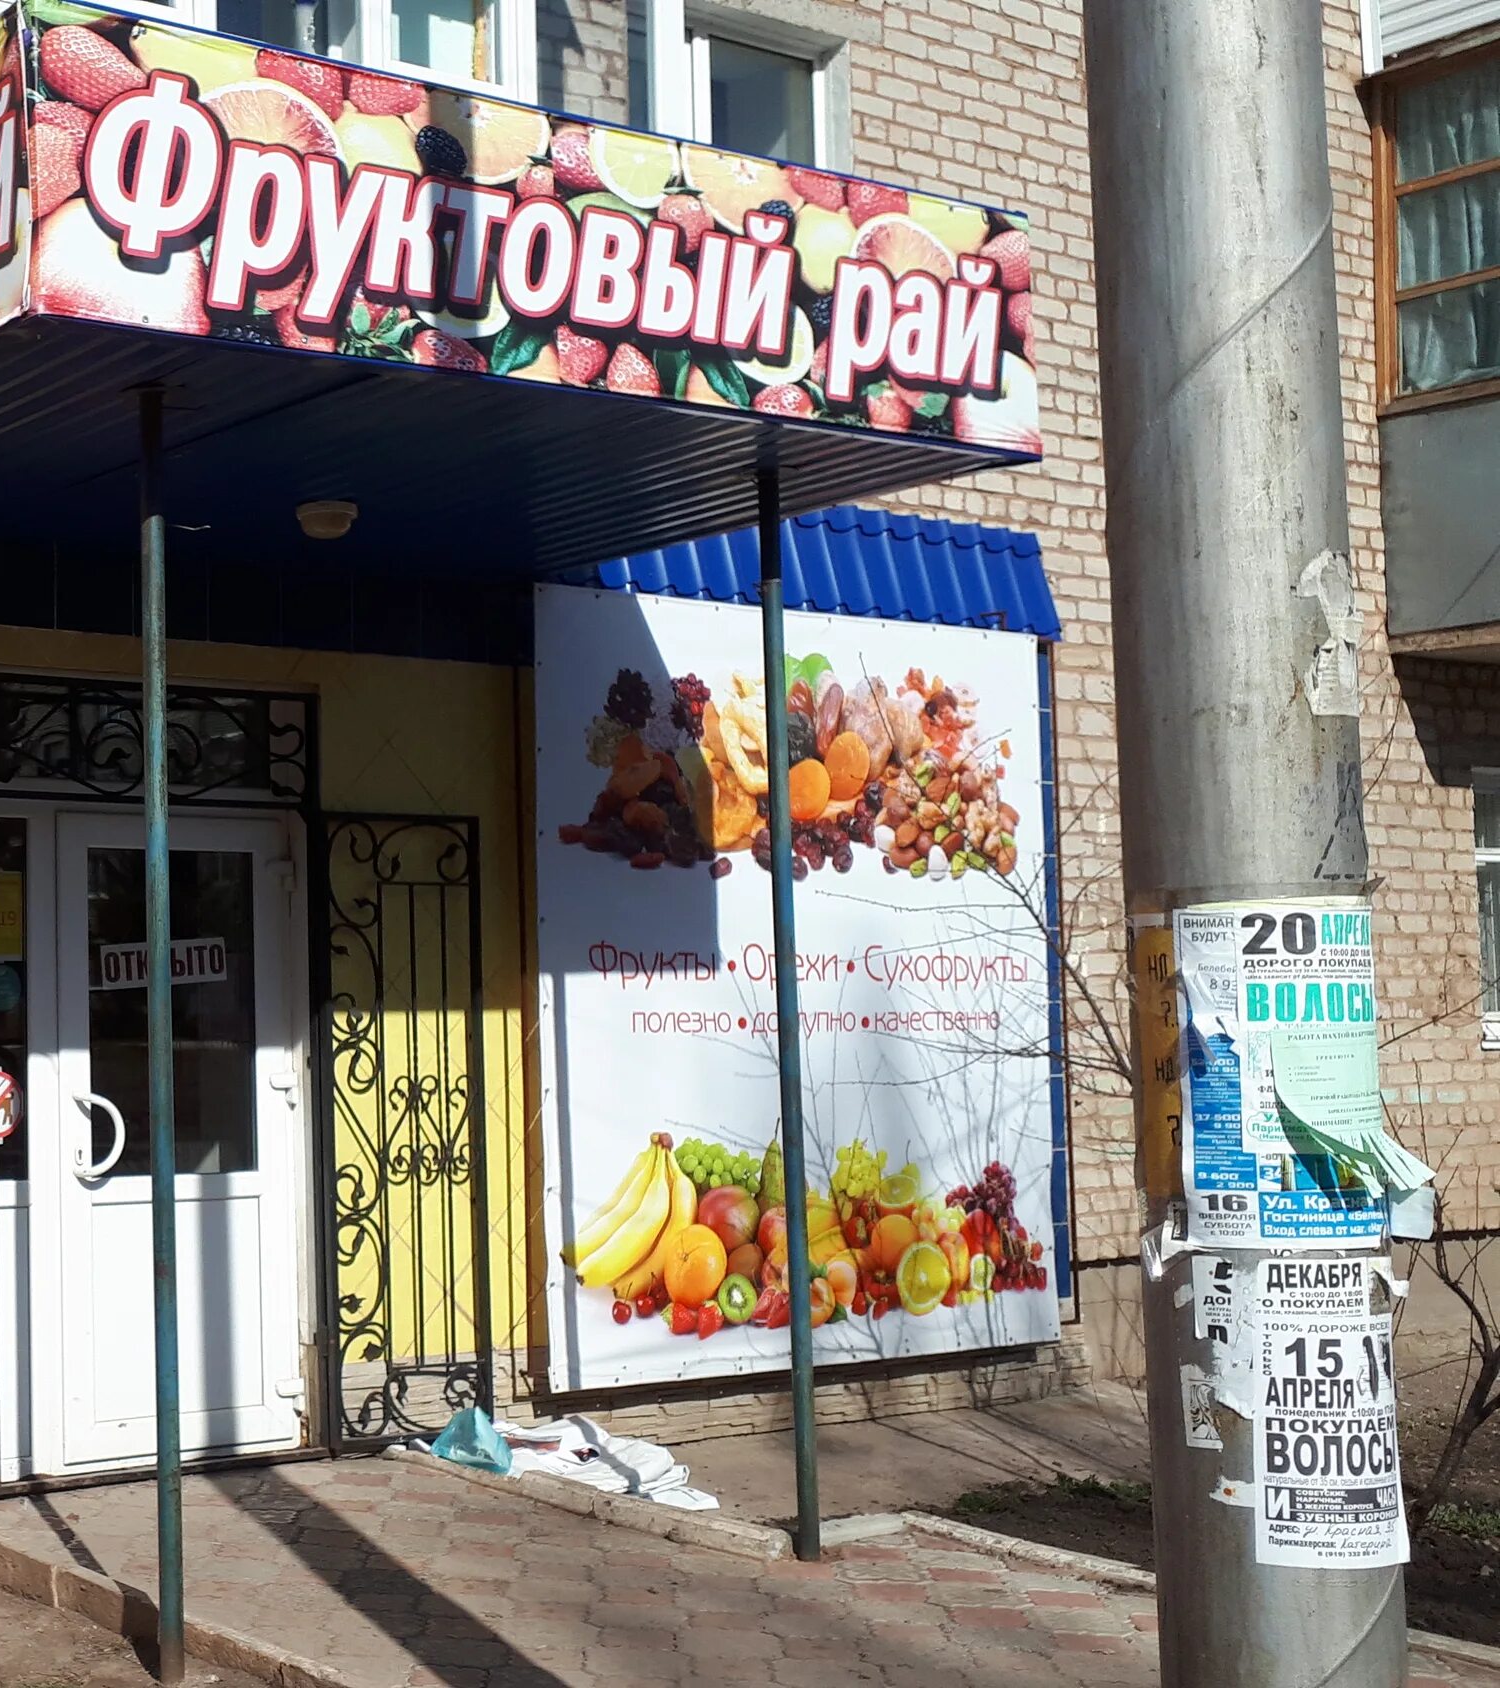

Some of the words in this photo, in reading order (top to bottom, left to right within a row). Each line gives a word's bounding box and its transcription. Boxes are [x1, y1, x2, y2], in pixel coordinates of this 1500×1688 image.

[85, 69, 796, 356] Фруктовый
[824, 254, 1001, 401] рай
[1191, 931, 1228, 943] БУДУТ
[1241, 912, 1316, 955] 20
[1329, 948, 1349, 957] 10:00
[103, 944, 225, 983] ОТКЫТО
[588, 940, 716, 990] Фрукты
[864, 945, 1028, 991] Сухофрукты
[1243, 958, 1314, 969] ДОРОГО
[1246, 983, 1373, 1022] ВОЛОСЫ
[632, 1011, 731, 1034] полезно
[874, 1010, 1001, 1033] качественно
[1201, 1193, 1249, 1212] 16
[1262, 1195, 1298, 1210] Ул.
[1198, 1212, 1257, 1221] ФЕВРАЛЯ
[1263, 1210, 1345, 1224] Гостиница
[1203, 1221, 1253, 1230] СУББОТА
[1264, 1224, 1297, 1237] Вход
[1299, 1226, 1334, 1236] слева
[1335, 1226, 1348, 1236] от
[1218, 1229, 1246, 1237] 10:00
[1267, 1263, 1362, 1293] ДЕКАБРЯ
[1327, 1291, 1341, 1299] ДО
[1280, 1297, 1364, 1309] ПОКУПАЕМ
[1263, 1322, 1303, 1333] 100%
[1307, 1323, 1367, 1333] ДОРОЖЕ
[1262, 1334, 1273, 1376] ТОЛЬКО
[1285, 1337, 1344, 1379] 15
[1265, 1377, 1354, 1409] АПРЕЛЯ
[1275, 1408, 1347, 1418] понедельник
[1265, 1415, 1395, 1434] ПОКУПАЕМ
[1266, 1431, 1396, 1476] ВОЛОСЫ
[1295, 1489, 1348, 1498] СОВЕТСКИЕ,
[1267, 1487, 1291, 1520] И
[1296, 1512, 1356, 1523] ЗУБНЫЕ
[1269, 1523, 1301, 1534] АДРЕС:
[1268, 1535, 1337, 1549] Парикмахерская:
